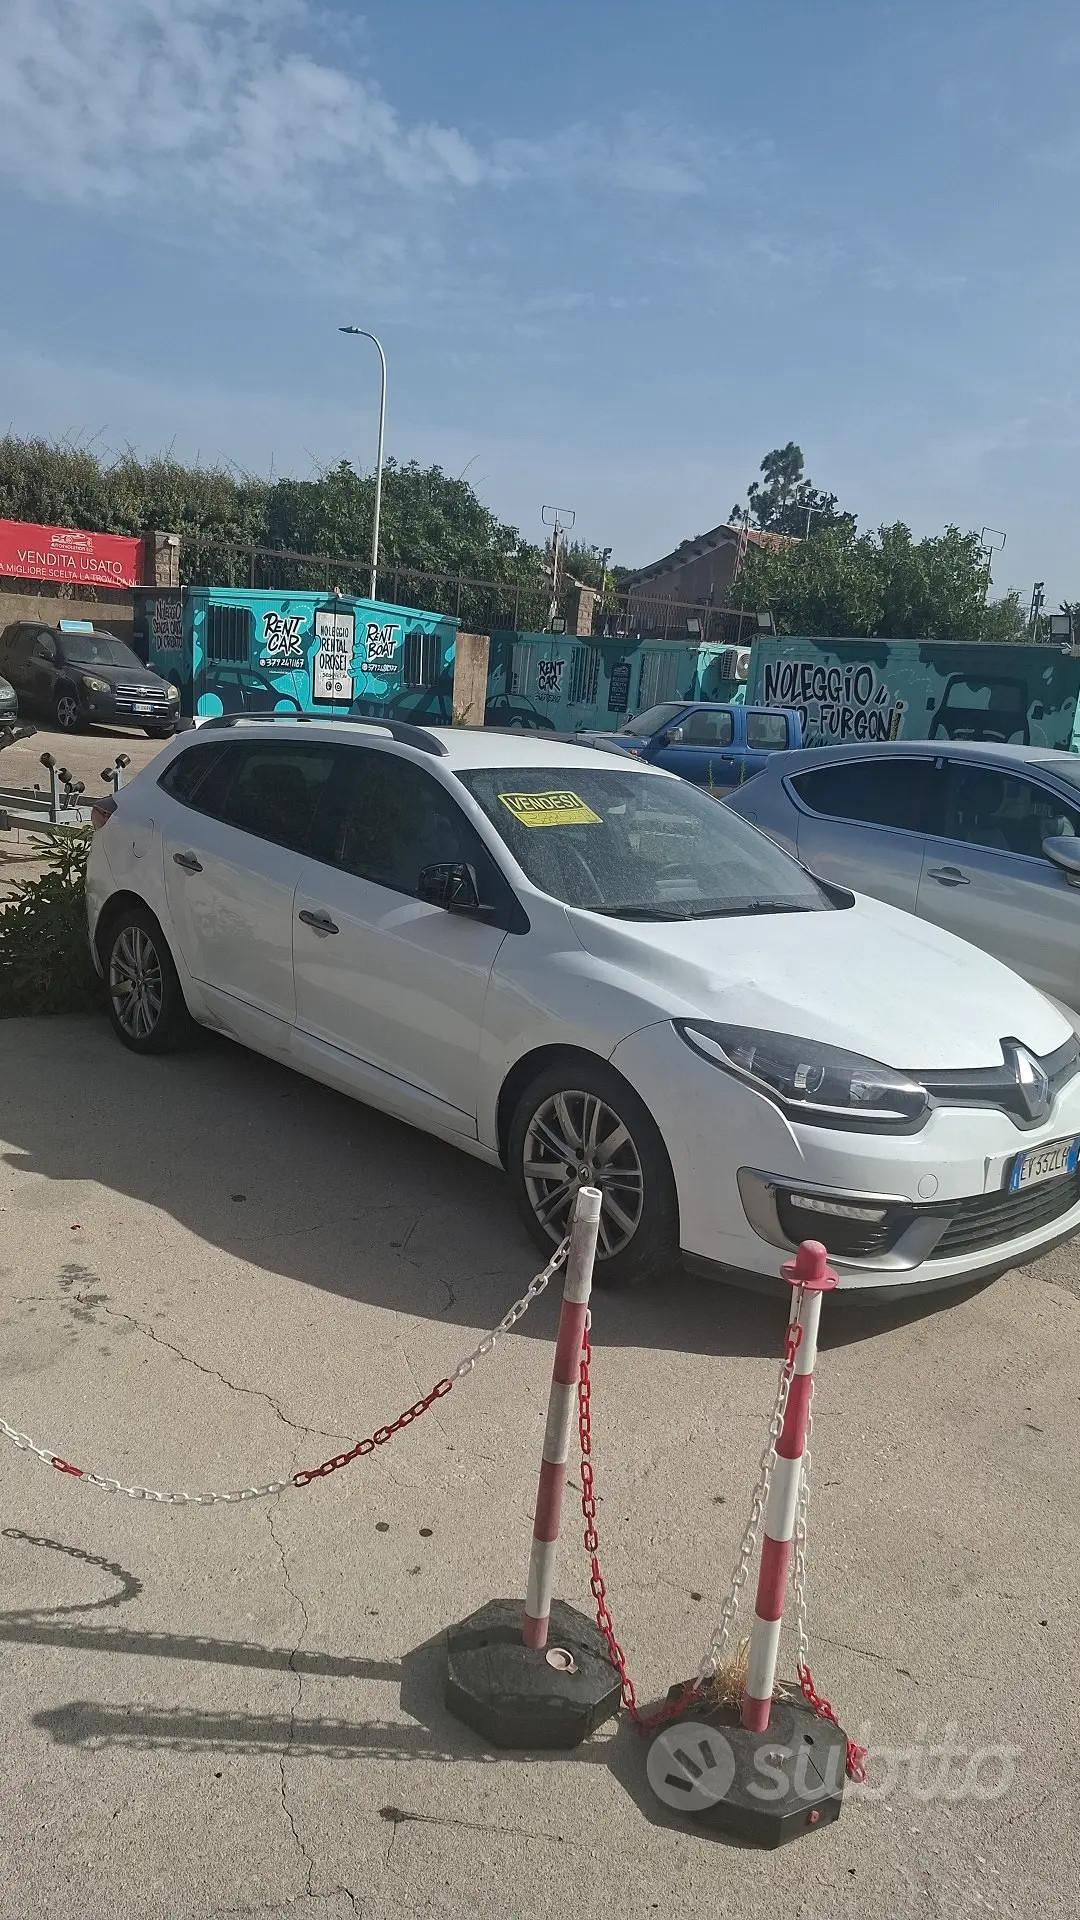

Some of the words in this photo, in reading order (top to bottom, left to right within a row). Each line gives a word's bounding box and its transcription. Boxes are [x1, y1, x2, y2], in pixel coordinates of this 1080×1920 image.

[17, 549, 77, 569] VENDITA
[80, 558, 122, 574] USATO
[6, 564, 46, 576] MIGLIORE
[48, 568, 77, 579] SCELTA
[79, 572, 90, 580] LA
[91, 573, 115, 583] TROVI
[263, 612, 305, 637] RENT
[320, 625, 349, 638] NOLEGGIO
[366, 623, 400, 643] RENT
[268, 634, 303, 656] CAR
[321, 637, 348, 653] RENTAL
[368, 641, 397, 658] BOAT
[319, 653, 348, 671] OROSEI
[538, 660, 565, 677] RENT
[538, 675, 561, 691] CAR
[507, 794, 580, 811] VENDESI
